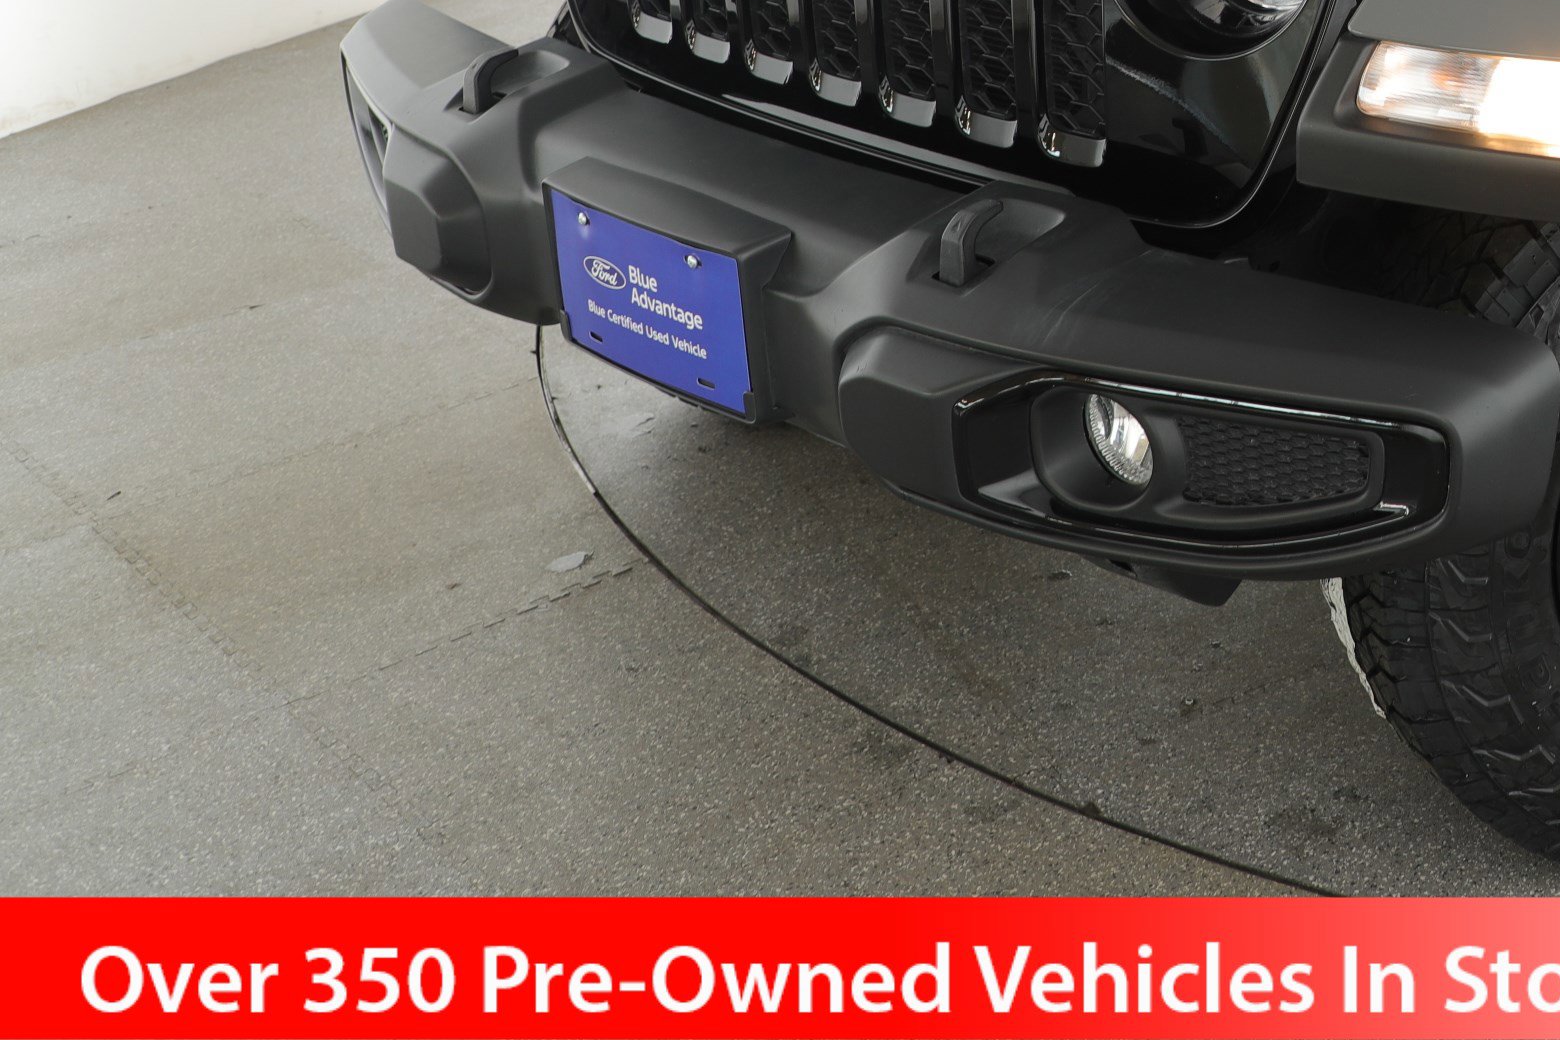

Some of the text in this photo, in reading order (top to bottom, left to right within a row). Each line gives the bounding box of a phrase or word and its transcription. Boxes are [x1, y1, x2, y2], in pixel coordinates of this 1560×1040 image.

[591, 259, 618, 286] Ford
[628, 264, 658, 293] Blue
[631, 287, 703, 330] Advantage
[588, 298, 707, 360] Blue Certified Used Vehicle
